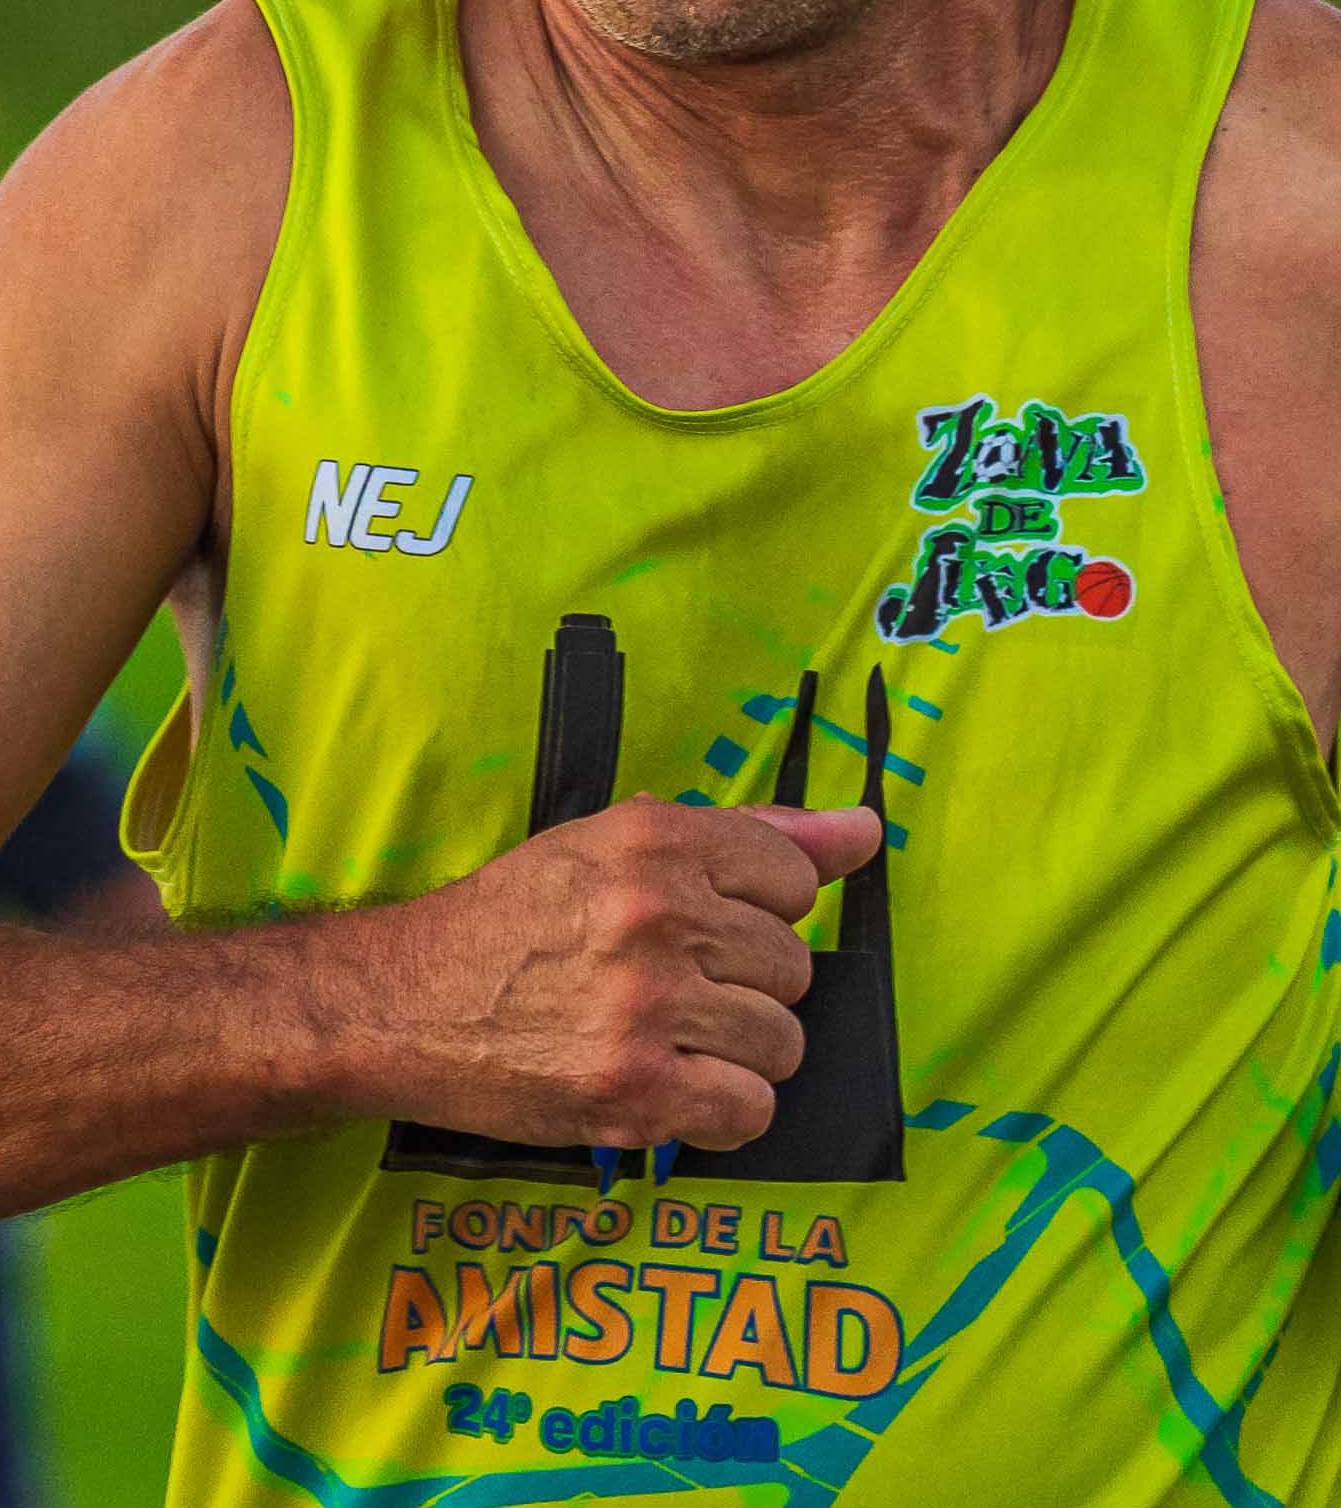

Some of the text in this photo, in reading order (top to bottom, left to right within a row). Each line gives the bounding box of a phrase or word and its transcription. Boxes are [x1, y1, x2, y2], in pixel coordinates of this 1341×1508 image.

[304, 459, 474, 557] NEJ
[978, 499, 1054, 536] DE
[651, 1199, 742, 1255] DE
[760, 1211, 848, 1268] LA
[377, 1259, 905, 1401] AMISTAD
[540, 1397, 780, 1462] edición
